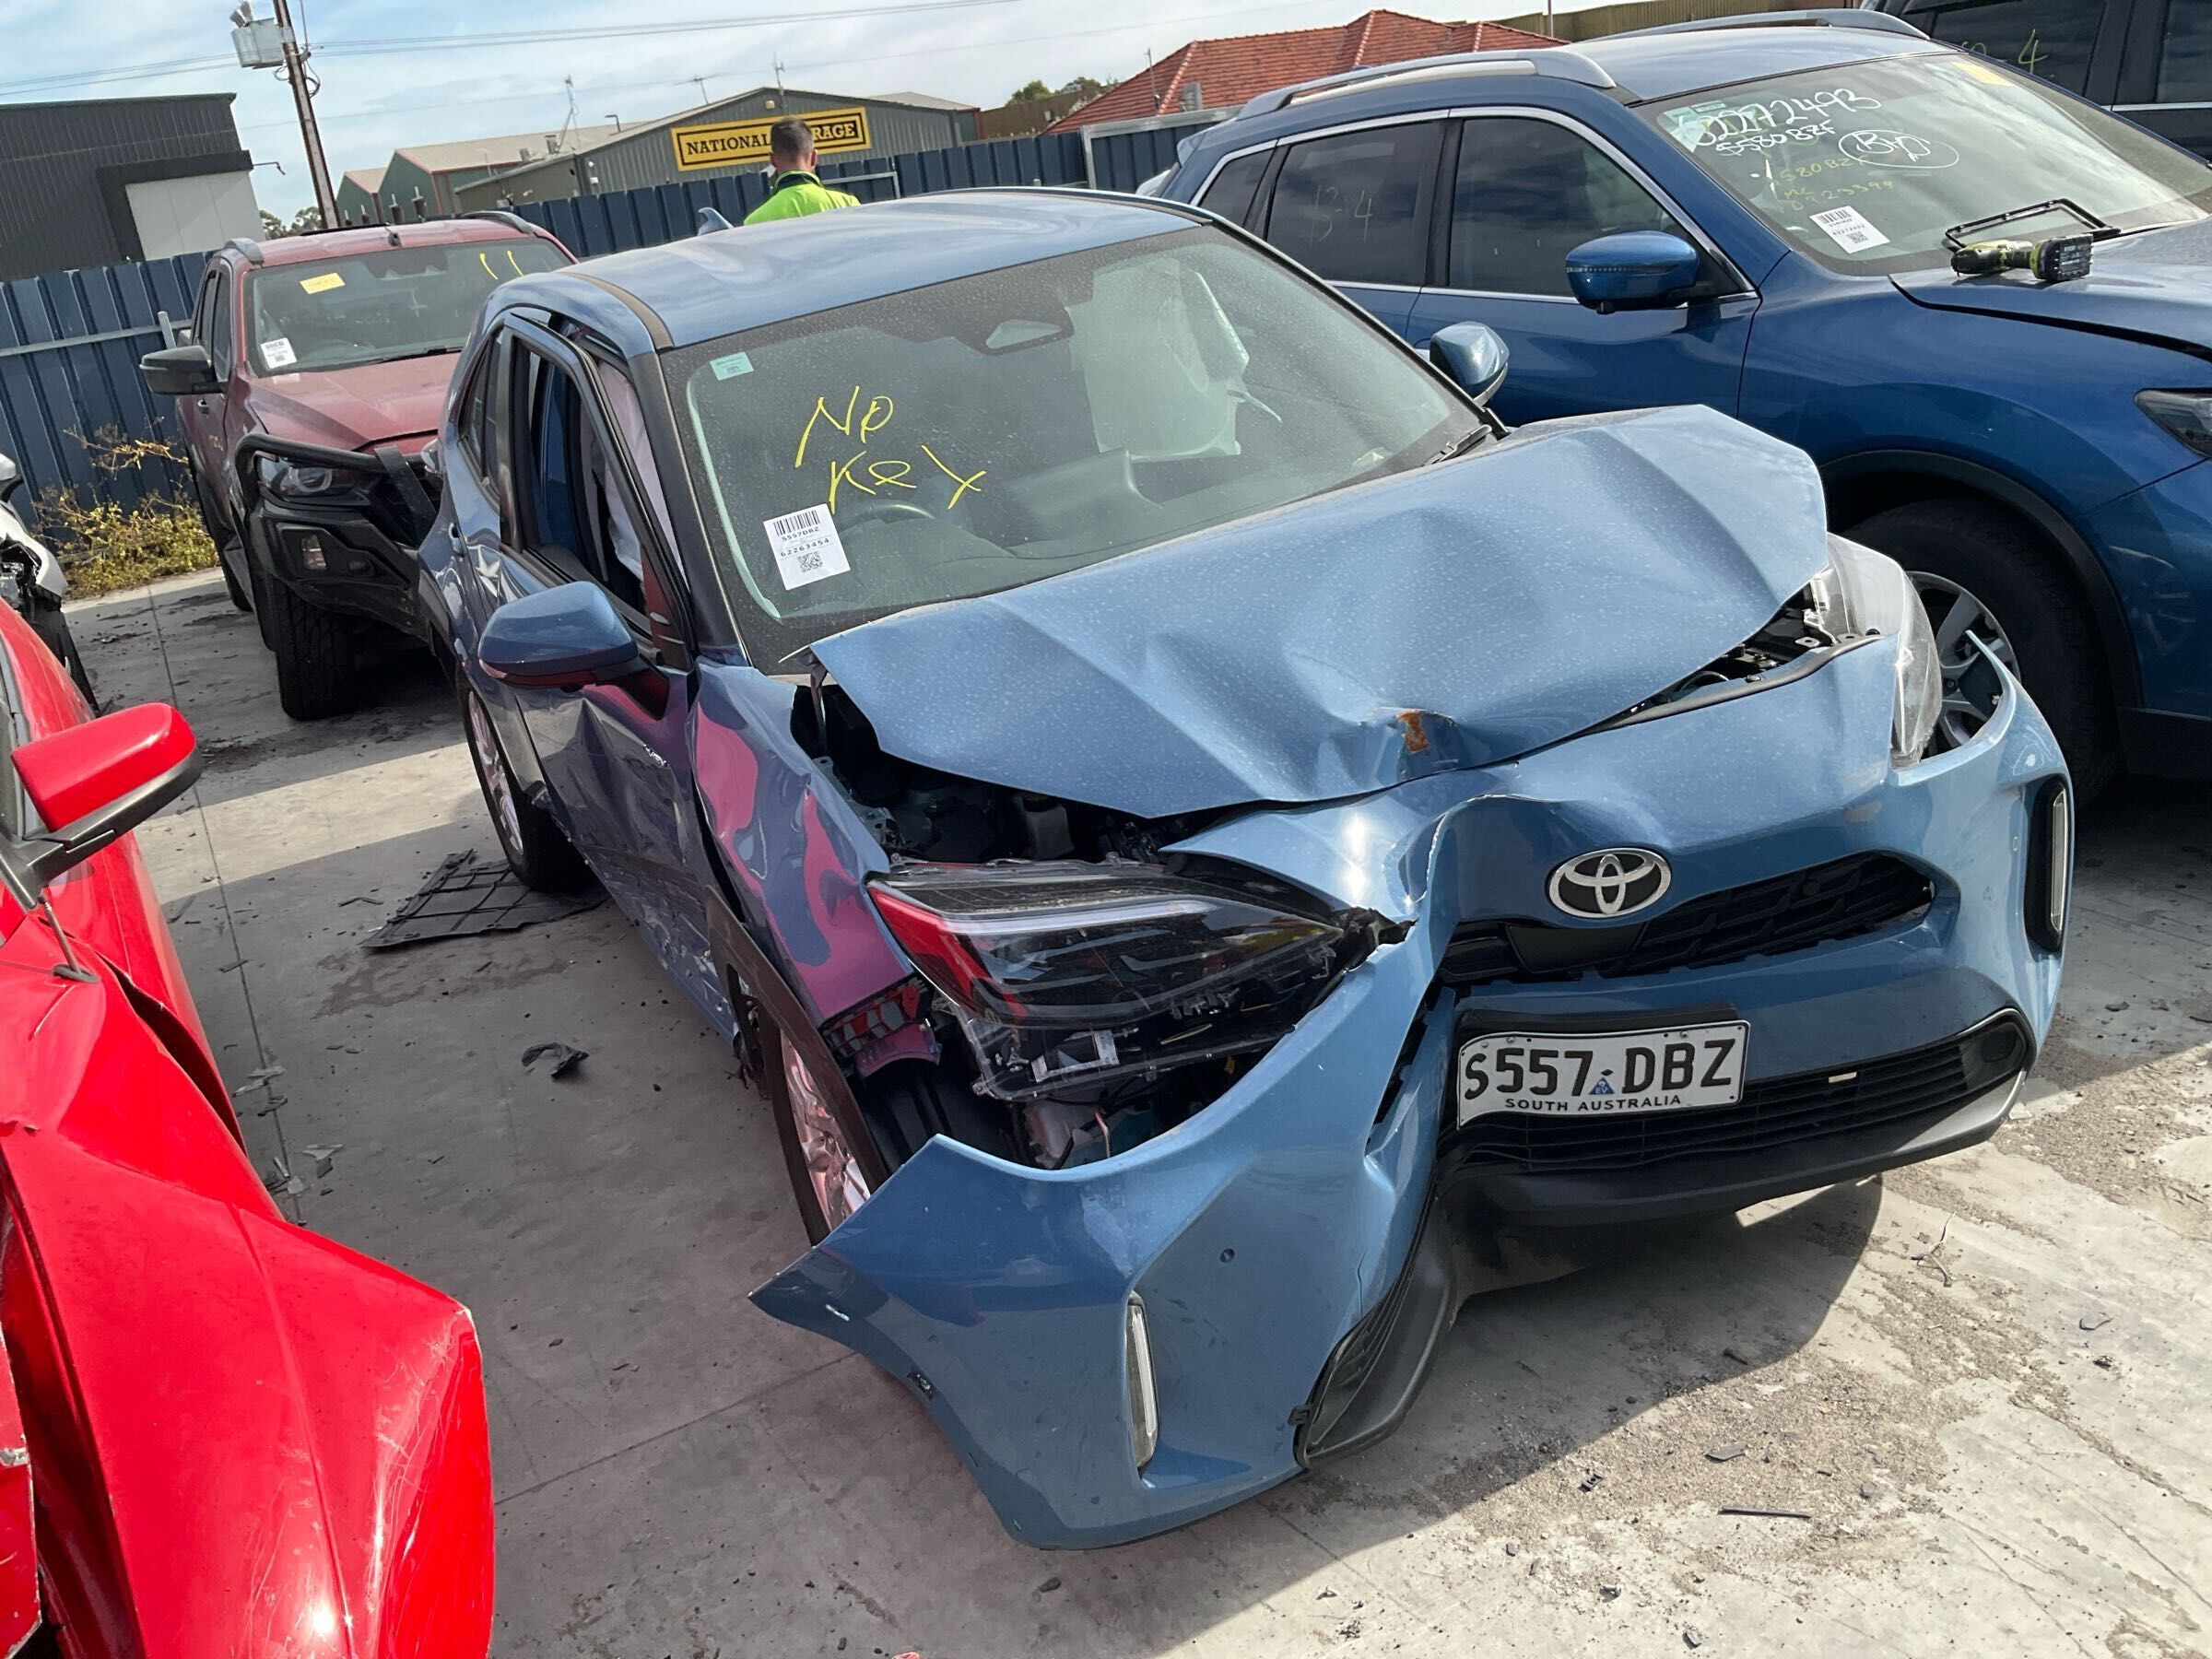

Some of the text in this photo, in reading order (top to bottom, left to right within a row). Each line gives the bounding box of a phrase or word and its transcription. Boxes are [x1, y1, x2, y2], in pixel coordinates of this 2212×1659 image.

[686, 134, 772, 156] NATIONAL
[782, 526, 820, 542] S557DBZ
[780, 537, 830, 559] 62263454
[1464, 1038, 1735, 1100] S557 DBZ
[1594, 1086, 1607, 1094] EV
[1505, 1094, 1682, 1112] SOUTH AUSTRALIA
